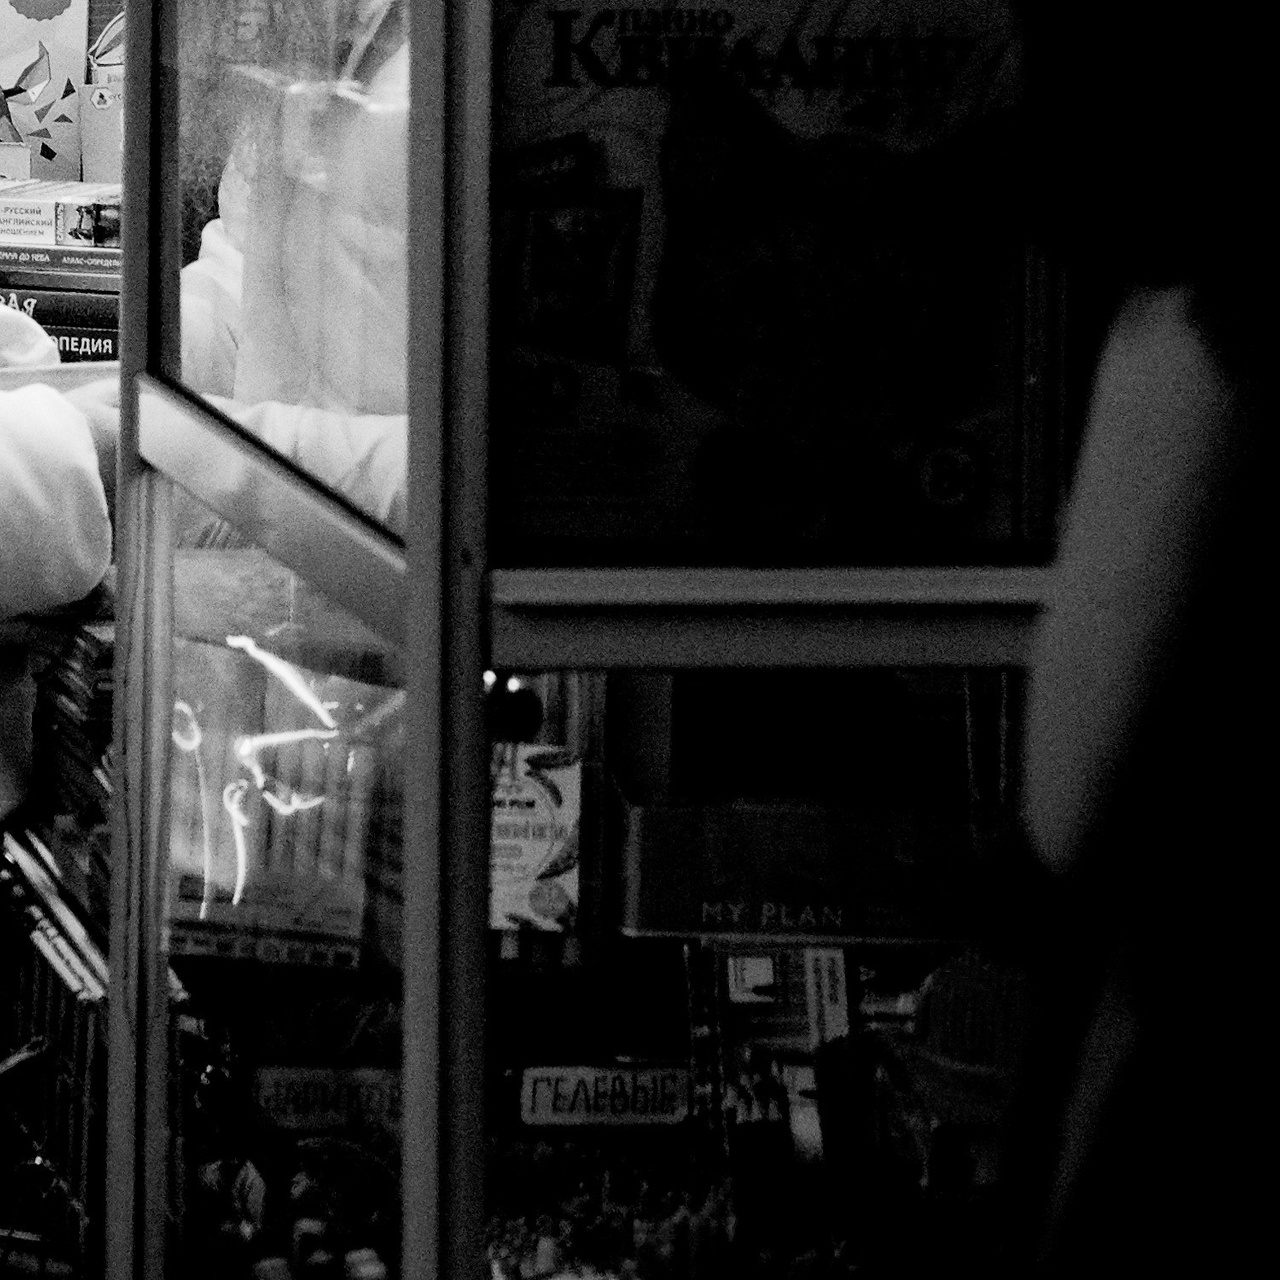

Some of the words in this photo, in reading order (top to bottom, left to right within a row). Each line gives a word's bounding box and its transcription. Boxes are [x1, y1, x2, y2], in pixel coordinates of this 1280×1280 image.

[702, 902, 747, 923] MY
[761, 902, 844, 926] PLAN
[530, 1075, 680, 1117] ГЕЛЕВЫЕ
